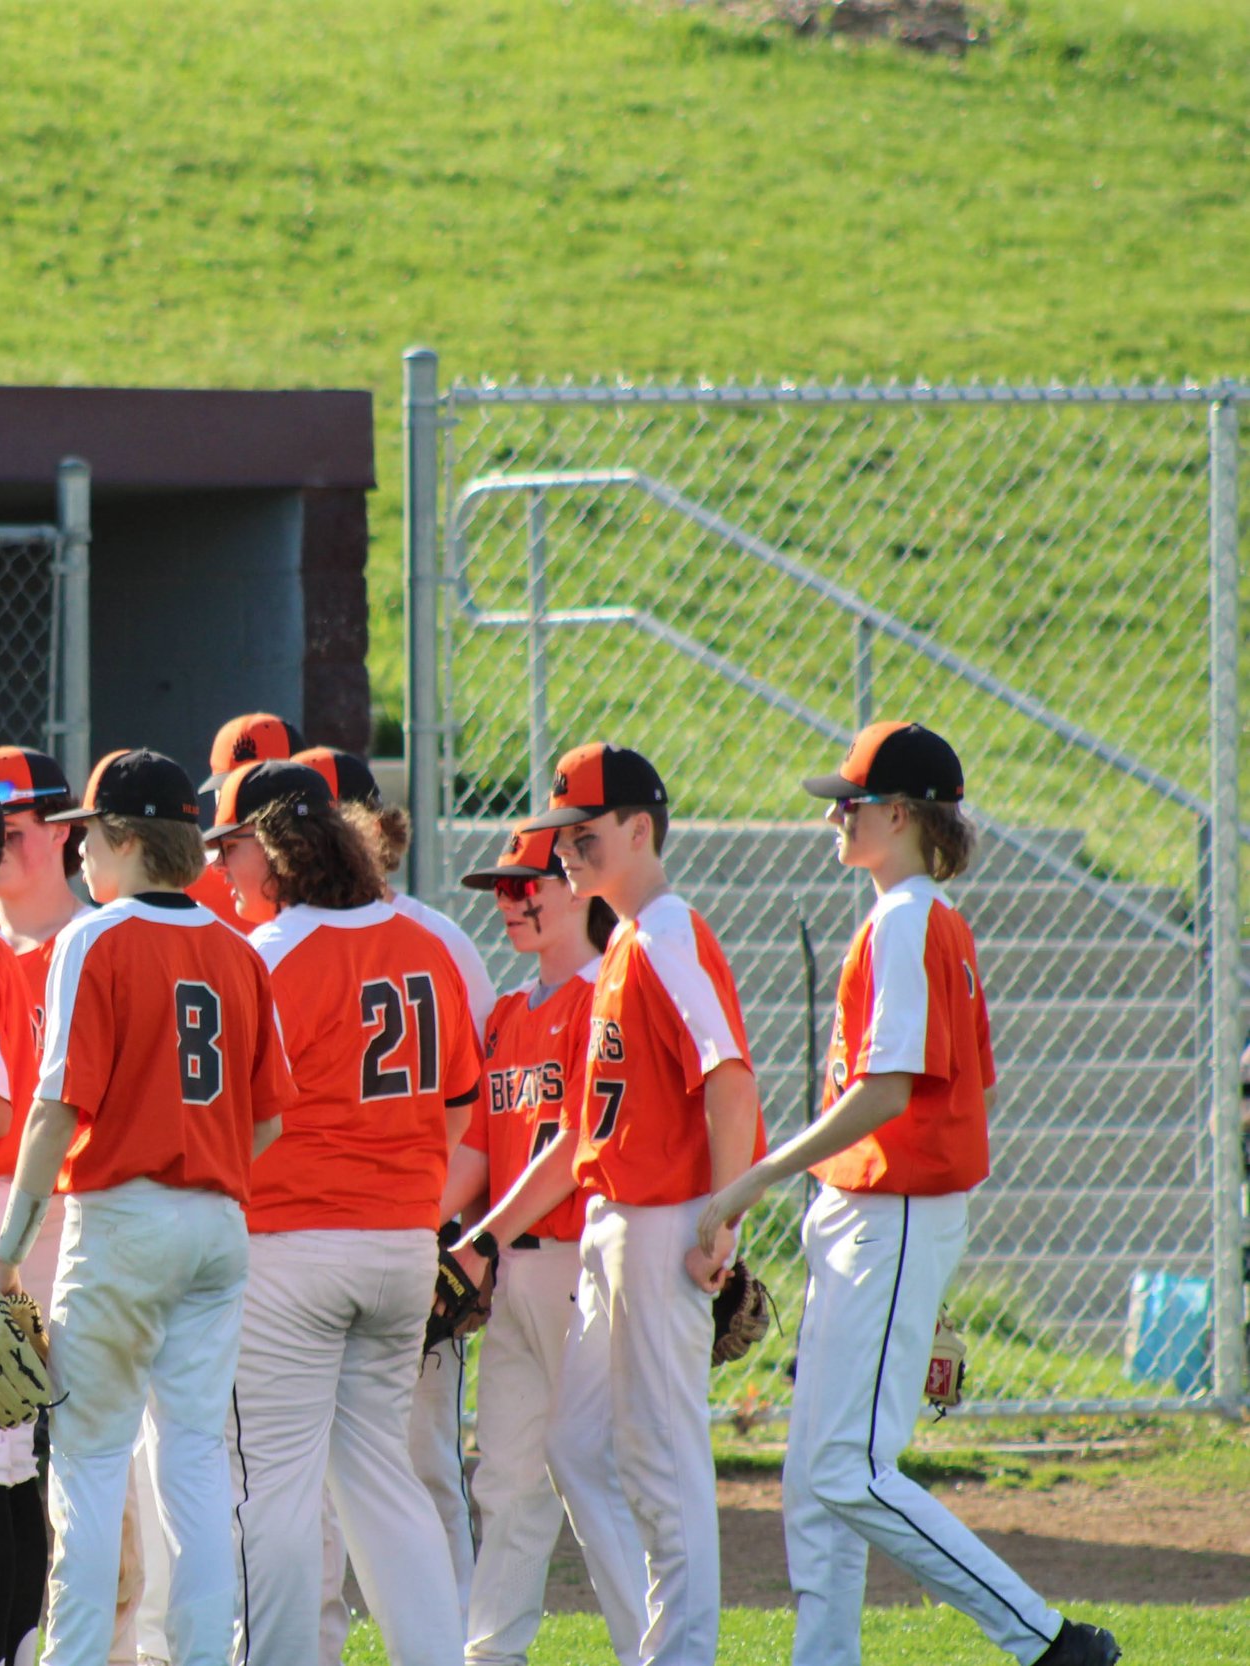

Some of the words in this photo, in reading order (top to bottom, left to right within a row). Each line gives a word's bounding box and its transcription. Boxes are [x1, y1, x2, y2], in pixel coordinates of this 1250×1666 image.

[174, 979, 223, 1106] 8
[359, 971, 440, 1104] 21
[593, 1078, 627, 1141] 7
